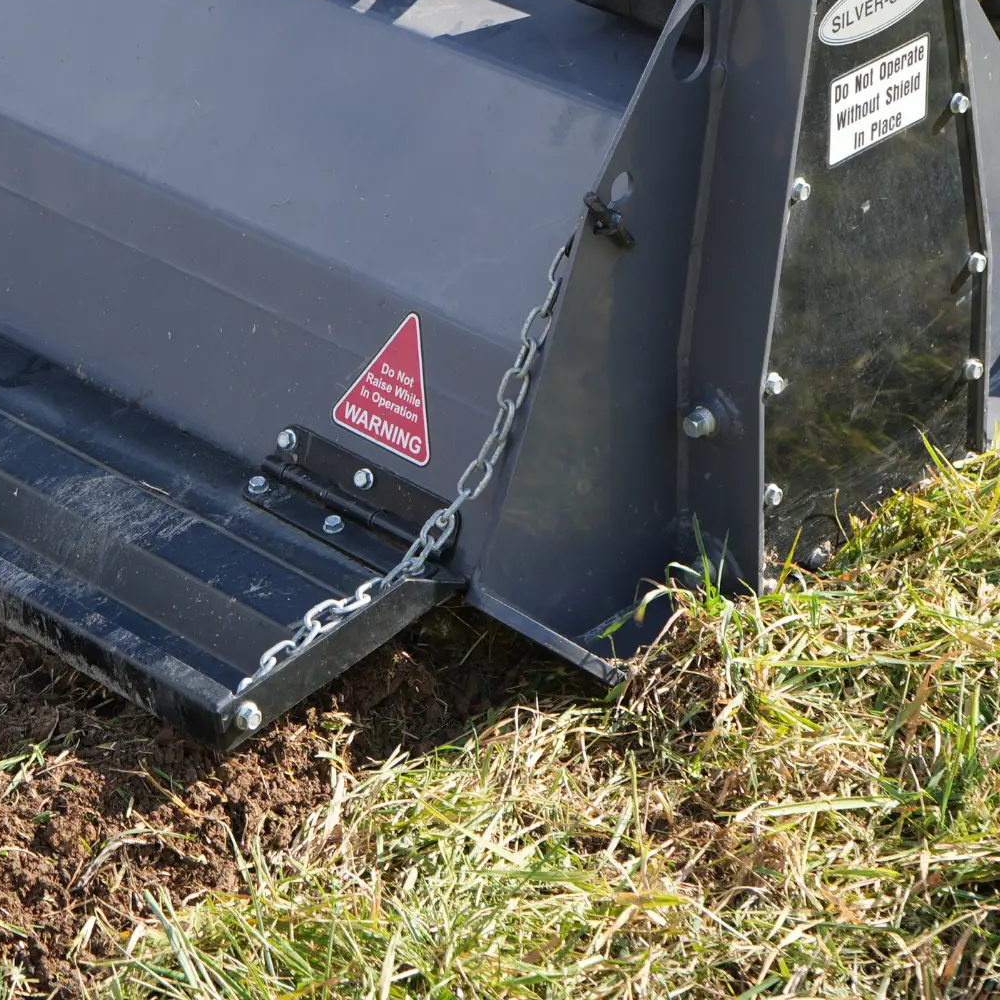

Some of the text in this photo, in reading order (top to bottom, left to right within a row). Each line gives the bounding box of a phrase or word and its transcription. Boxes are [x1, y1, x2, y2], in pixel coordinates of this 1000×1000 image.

[834, 45, 924, 104] Do Not Operate
[836, 72, 920, 131] Without Shield
[853, 111, 902, 150] In Place
[366, 372, 420, 407] Raise While
[381, 363, 414, 388] Do Not
[360, 386, 418, 423] In Operation
[344, 401, 422, 455] WARNING
